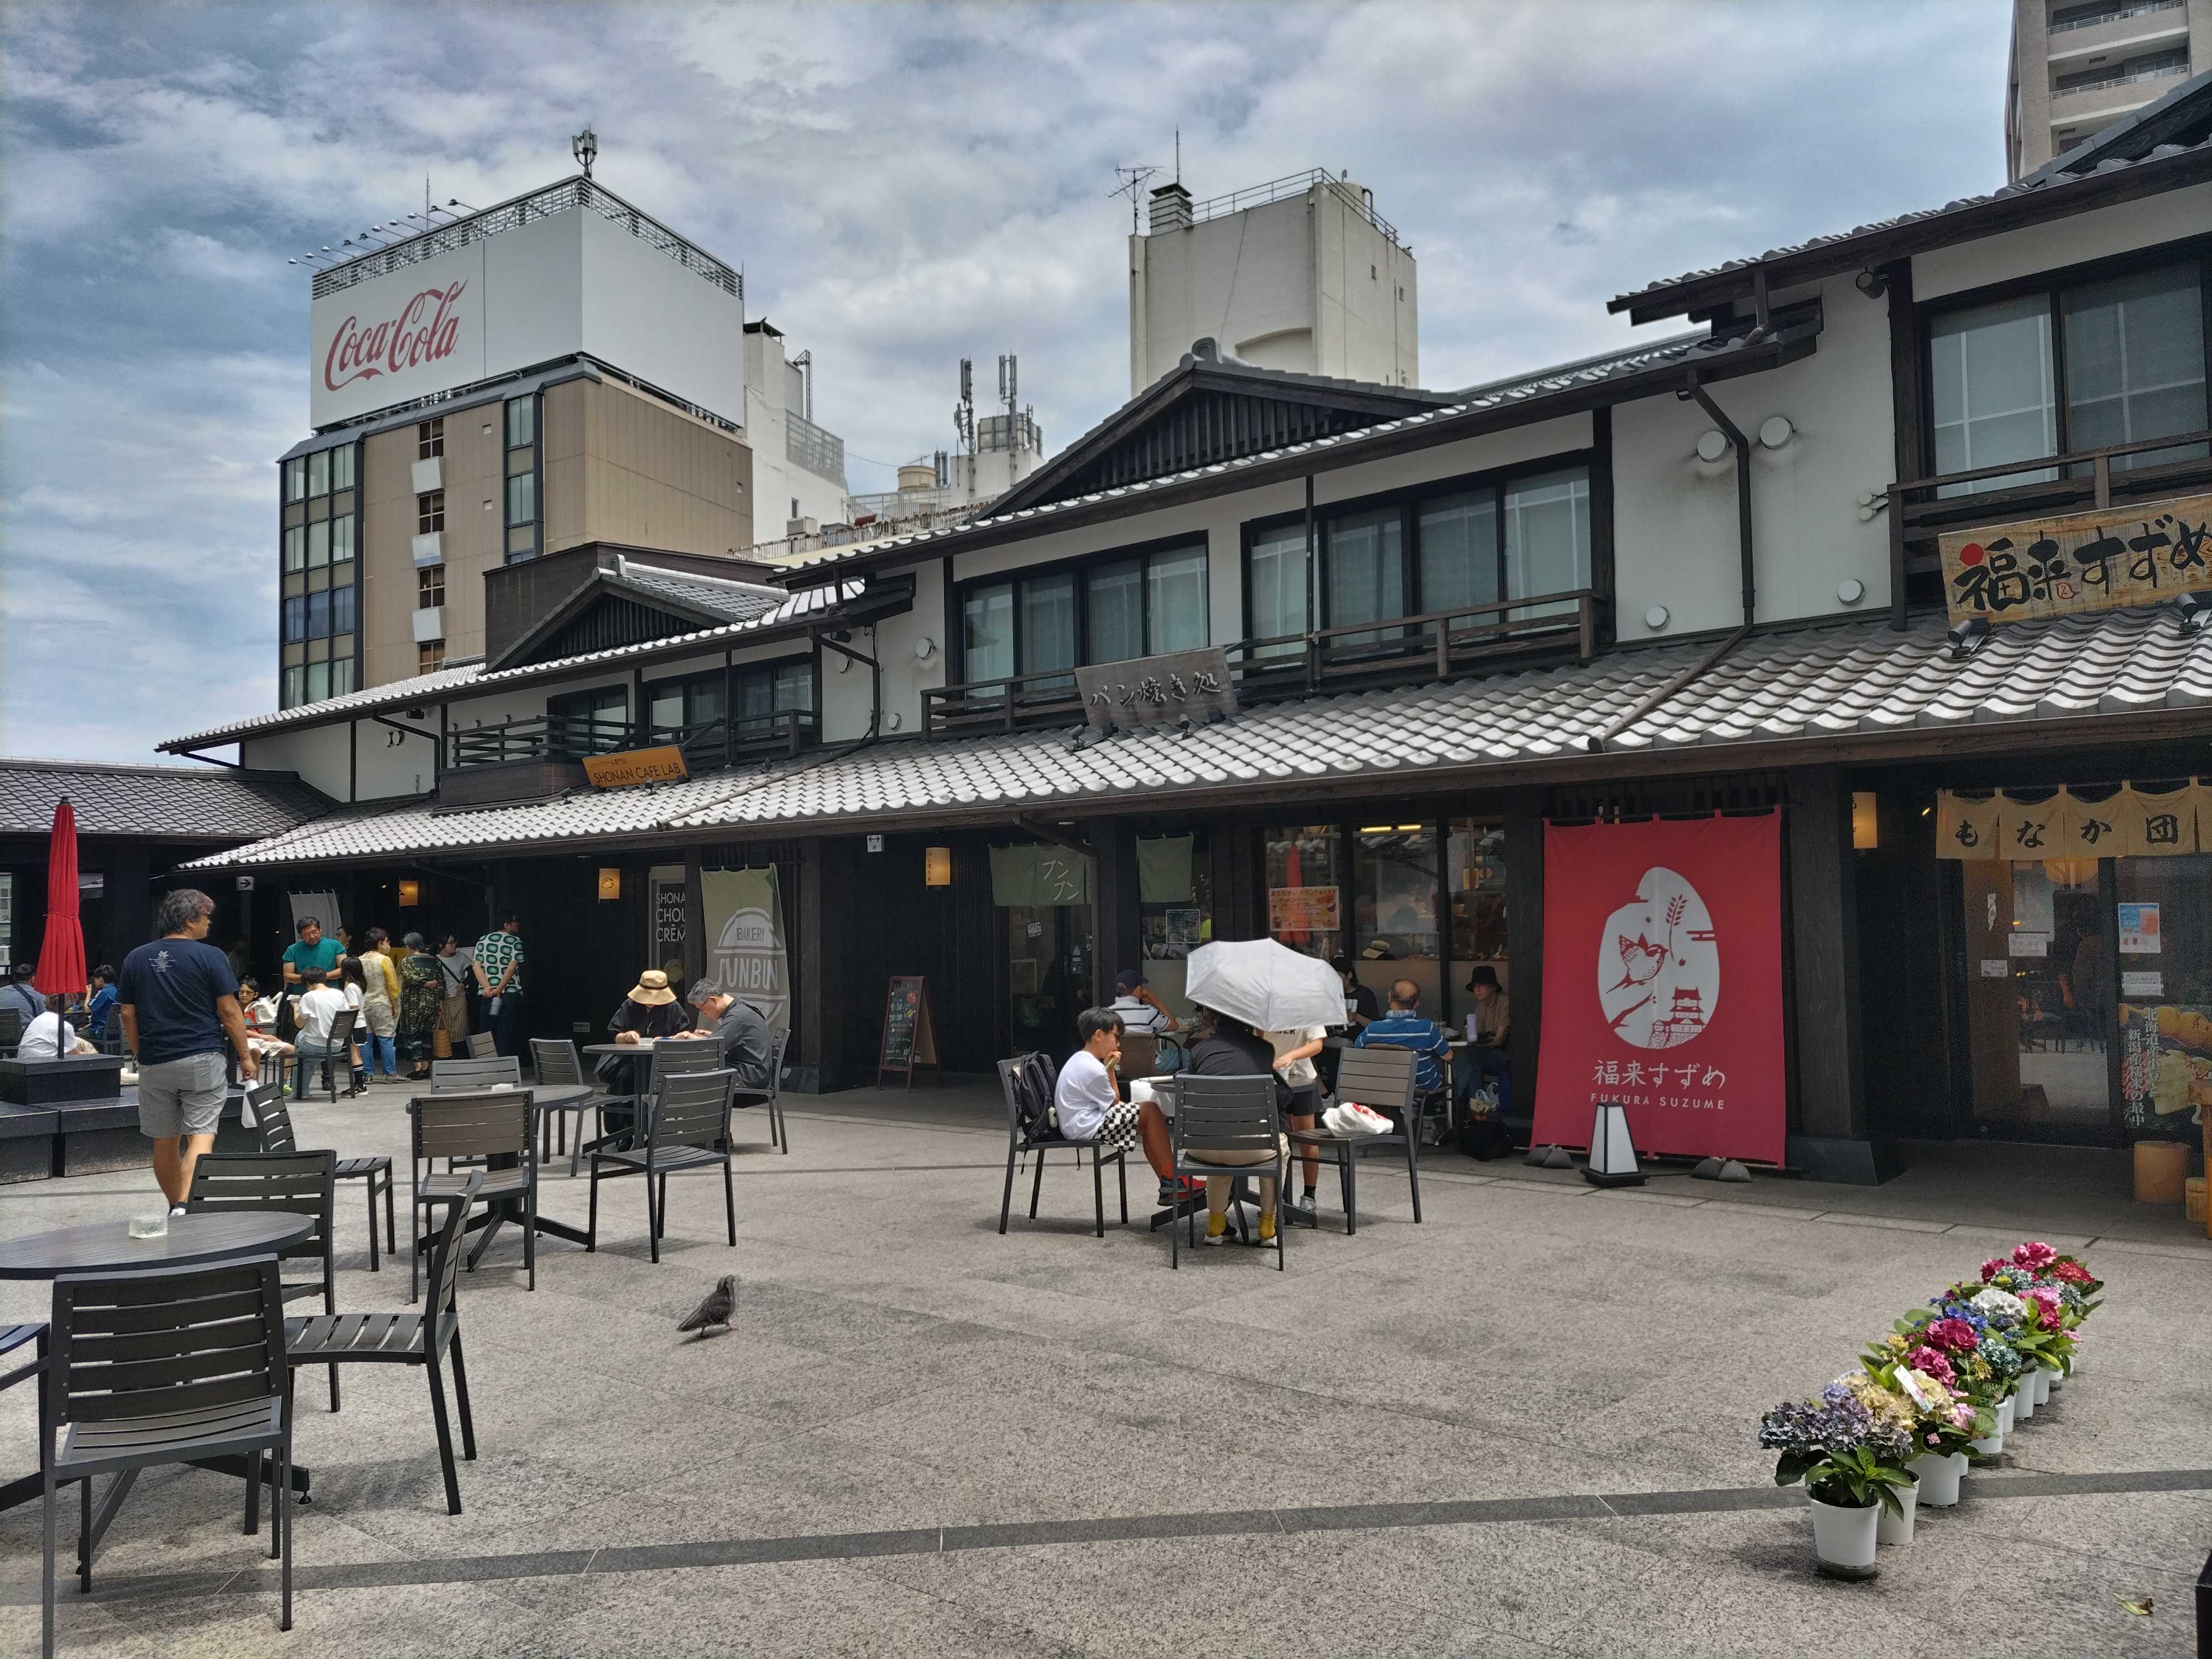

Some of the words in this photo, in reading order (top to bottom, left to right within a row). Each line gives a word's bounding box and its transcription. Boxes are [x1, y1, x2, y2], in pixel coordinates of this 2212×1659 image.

[325, 277, 469, 391] Coca-Cola
[1090, 671, 1221, 706] パン焼き処
[593, 769, 634, 784] SHONAN
[635, 765, 660, 779] CAFE
[661, 762, 681, 775] LAB
[736, 927, 765, 941] BAKERY
[1593, 1059, 1726, 1090] 福来すずめ
[1590, 1093, 1650, 1105] FUKURA
[1660, 1097, 1724, 1109] SUZUME
